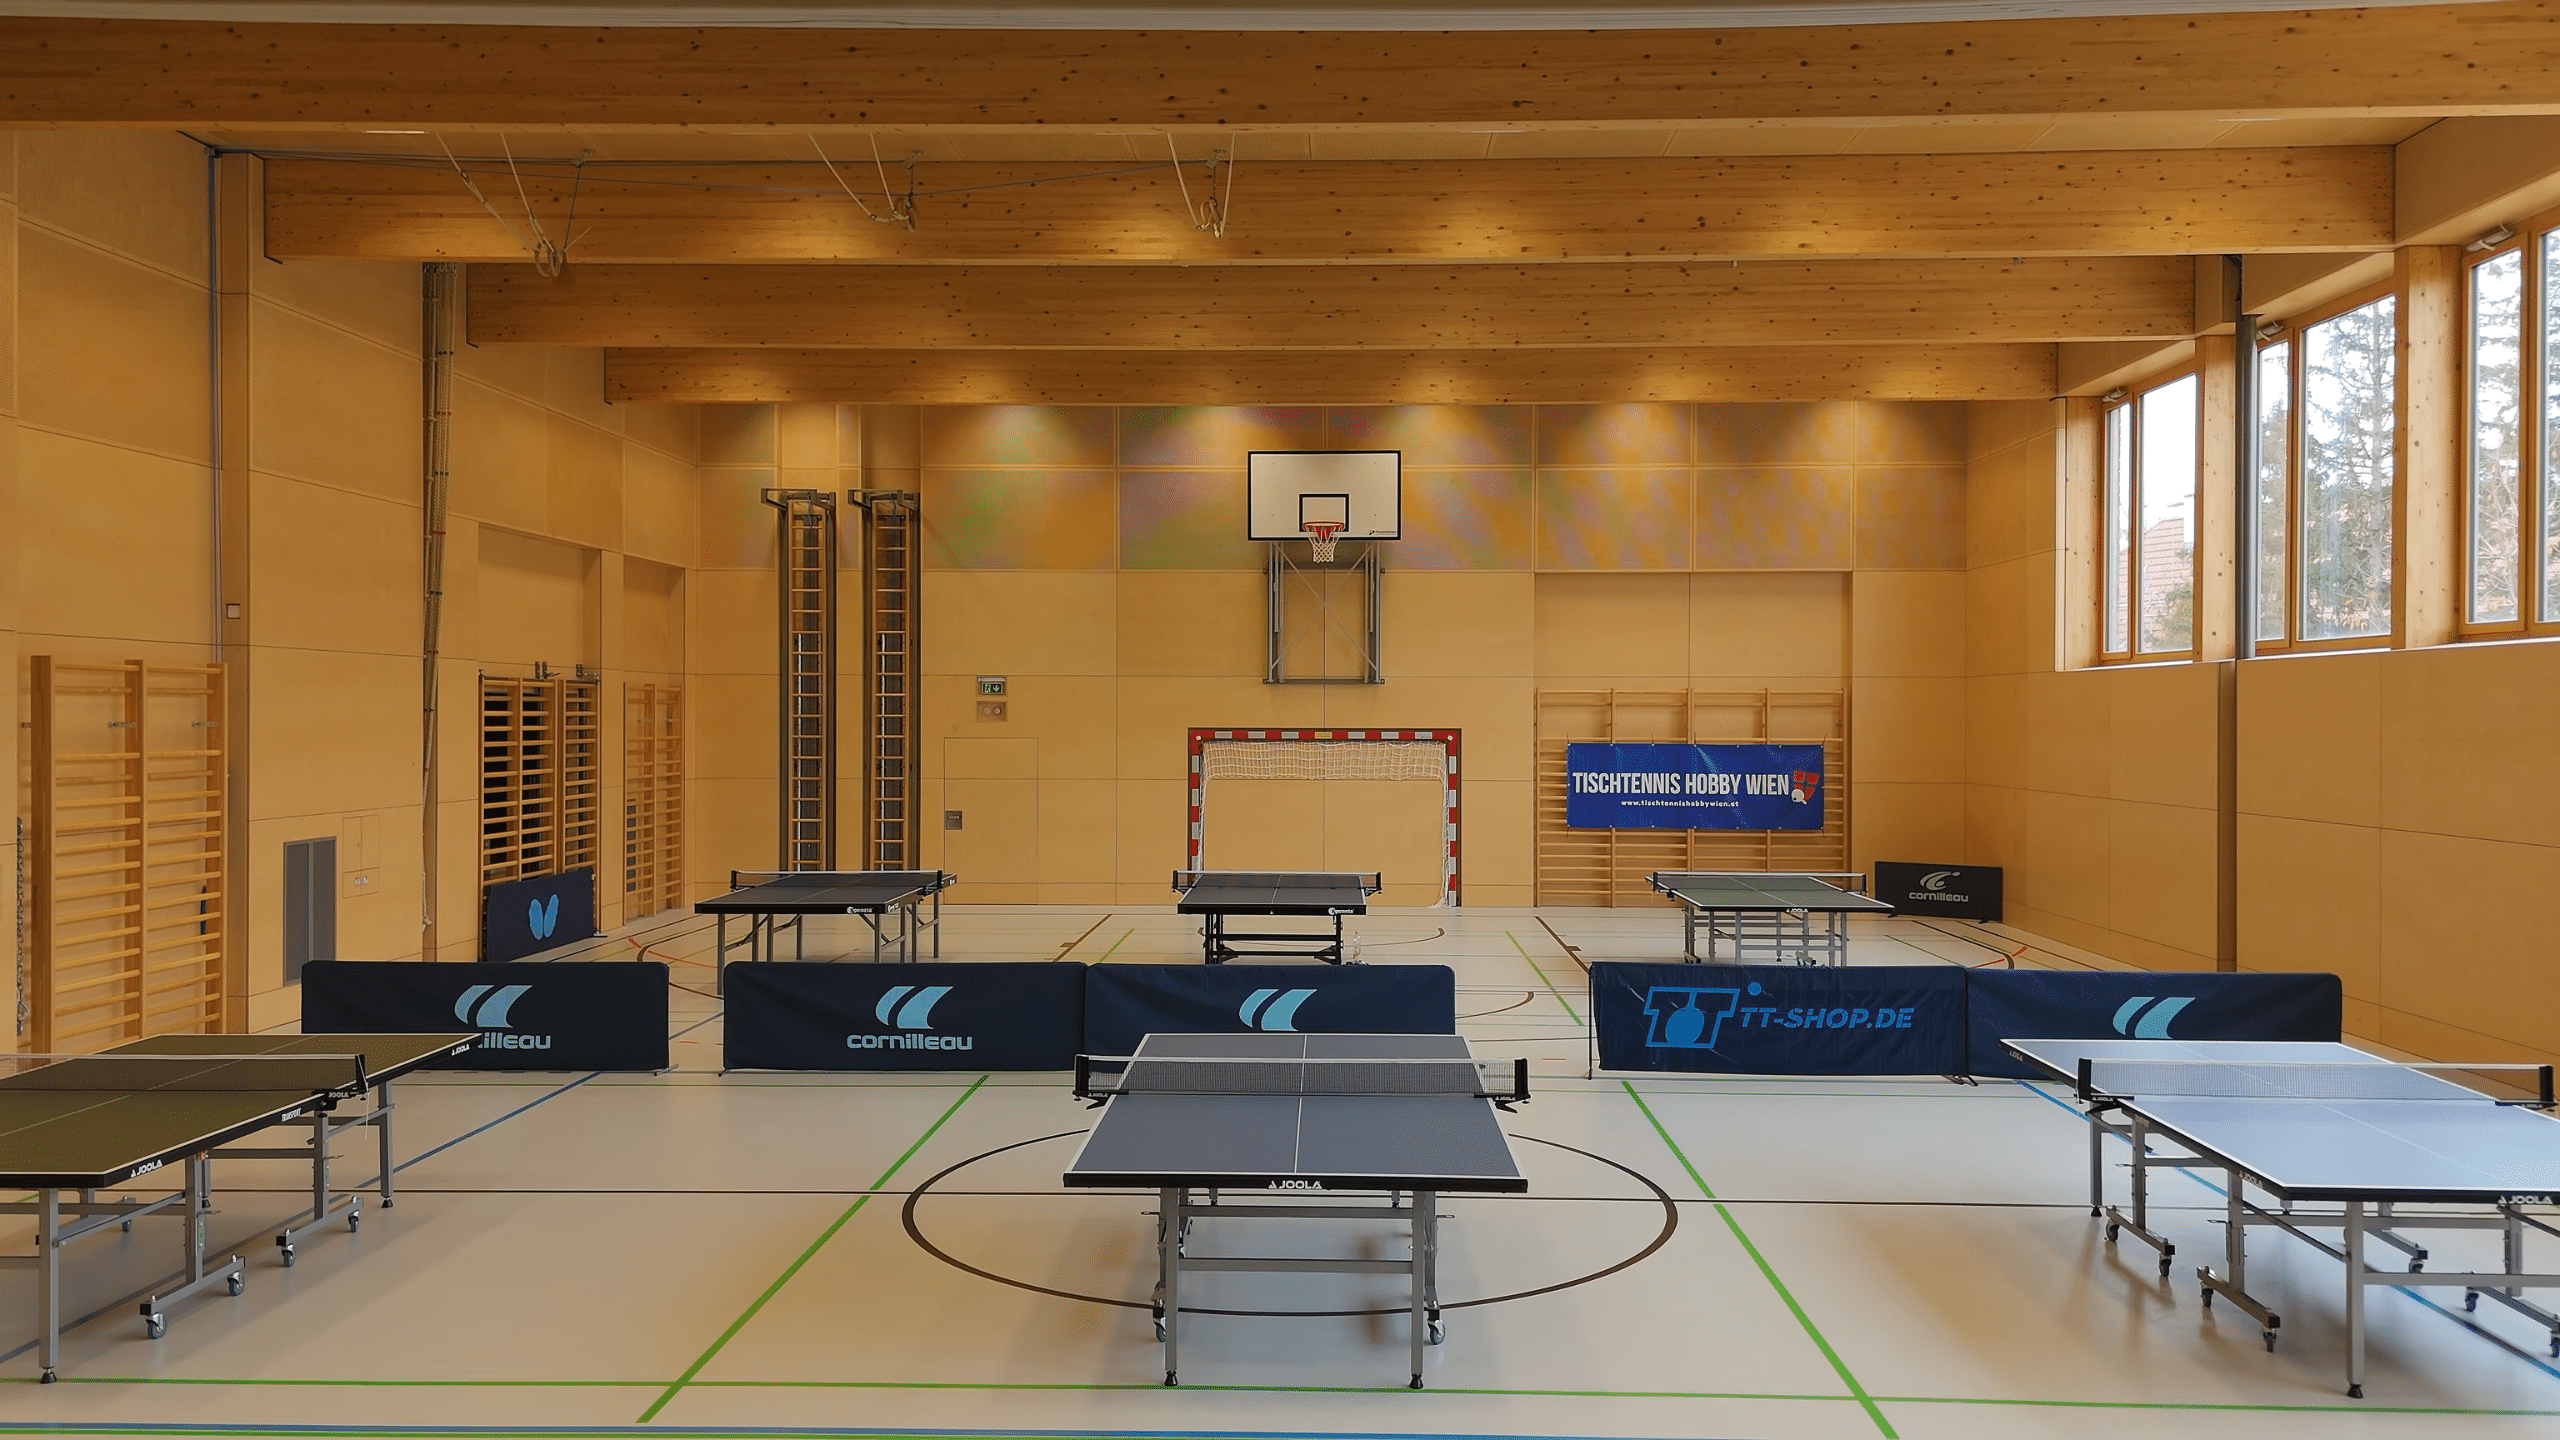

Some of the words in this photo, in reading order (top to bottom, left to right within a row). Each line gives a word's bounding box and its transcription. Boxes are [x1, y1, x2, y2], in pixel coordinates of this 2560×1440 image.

[1572, 772, 1681, 794] TISCHTENNIS
[1685, 773, 1742, 795] HOBBY
[1745, 774, 1790, 796] WIEN
[1621, 799, 1739, 807] www.tischtennishobbywien.at
[1908, 891, 1969, 902] cornilleau
[1740, 1007, 1914, 1028] TT-SHOP.DE
[478, 1032, 551, 1049] illeau
[846, 1033, 972, 1050] cornilleau
[137, 1159, 162, 1176] JOOLA
[1279, 1180, 1322, 1189] JOOLA
[2508, 1195, 2553, 1204] JOOLA
